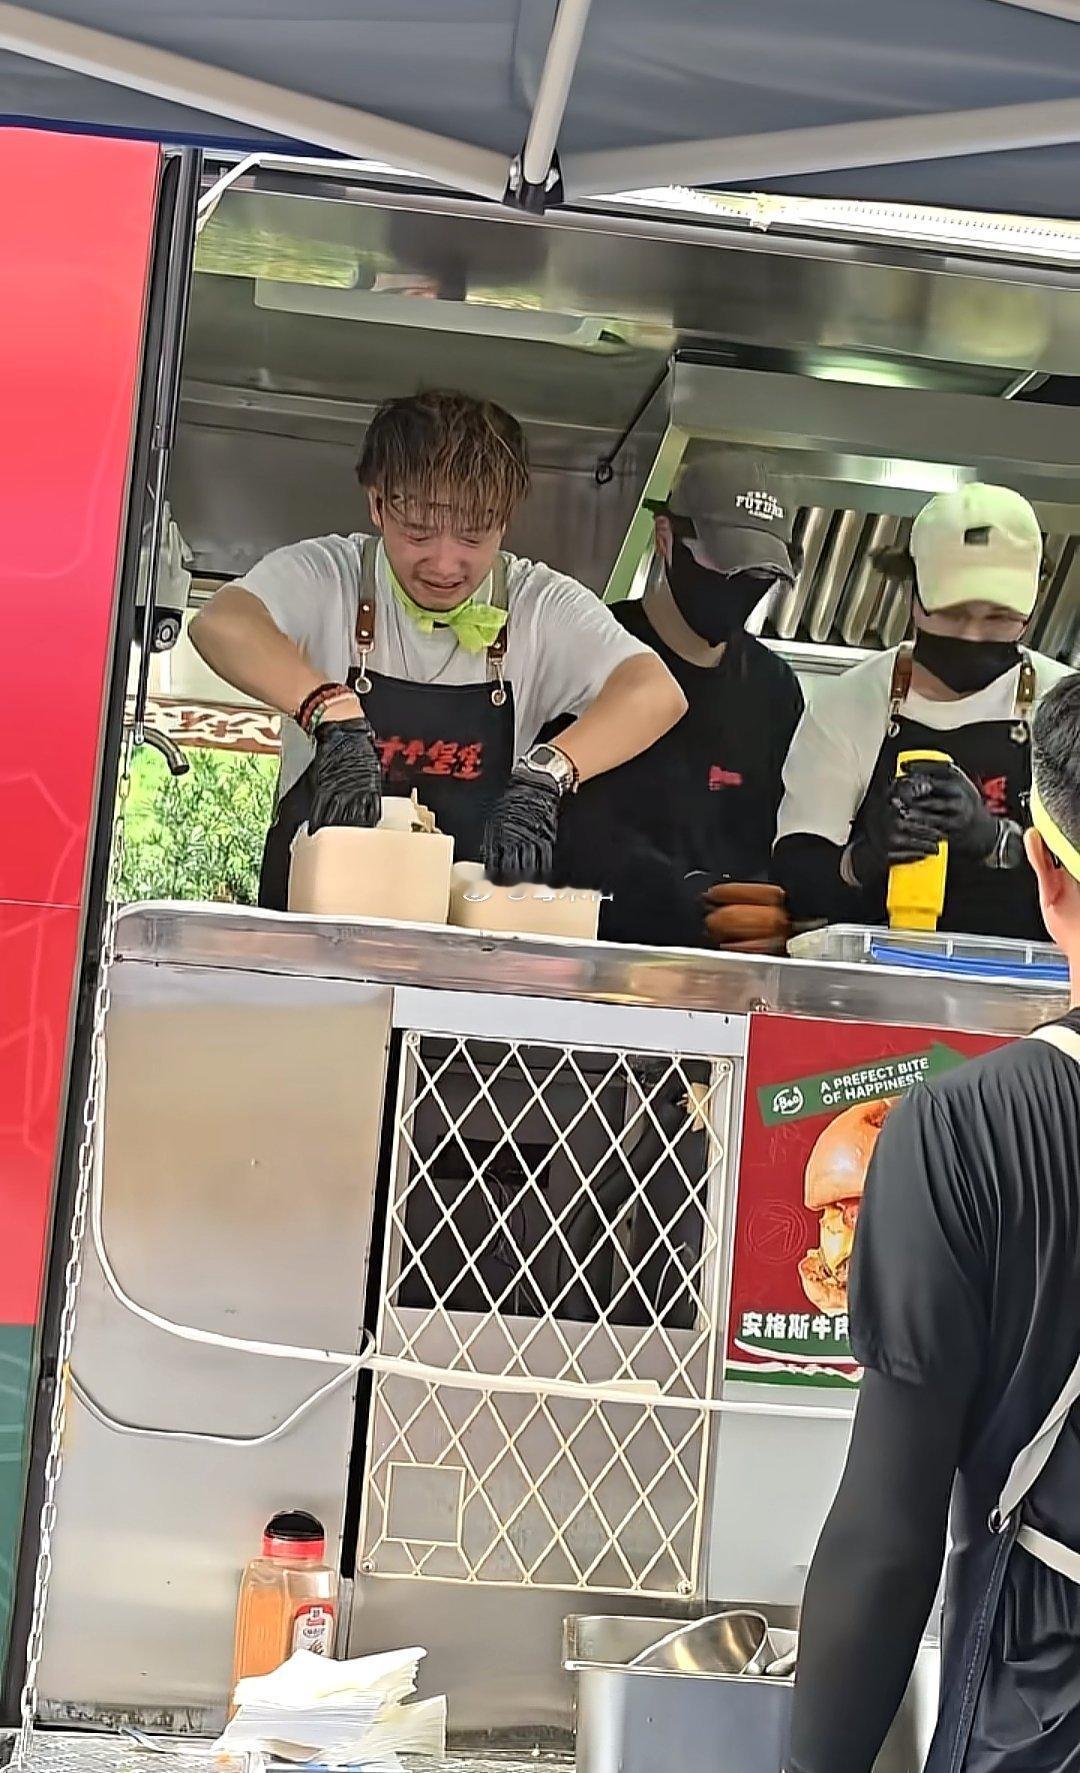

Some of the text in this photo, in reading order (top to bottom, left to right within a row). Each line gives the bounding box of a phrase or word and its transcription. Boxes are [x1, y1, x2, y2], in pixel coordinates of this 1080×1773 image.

[819, 1057, 930, 1094] A PREFECT BITE
[822, 1072, 924, 1105] OF HAPPINESS
